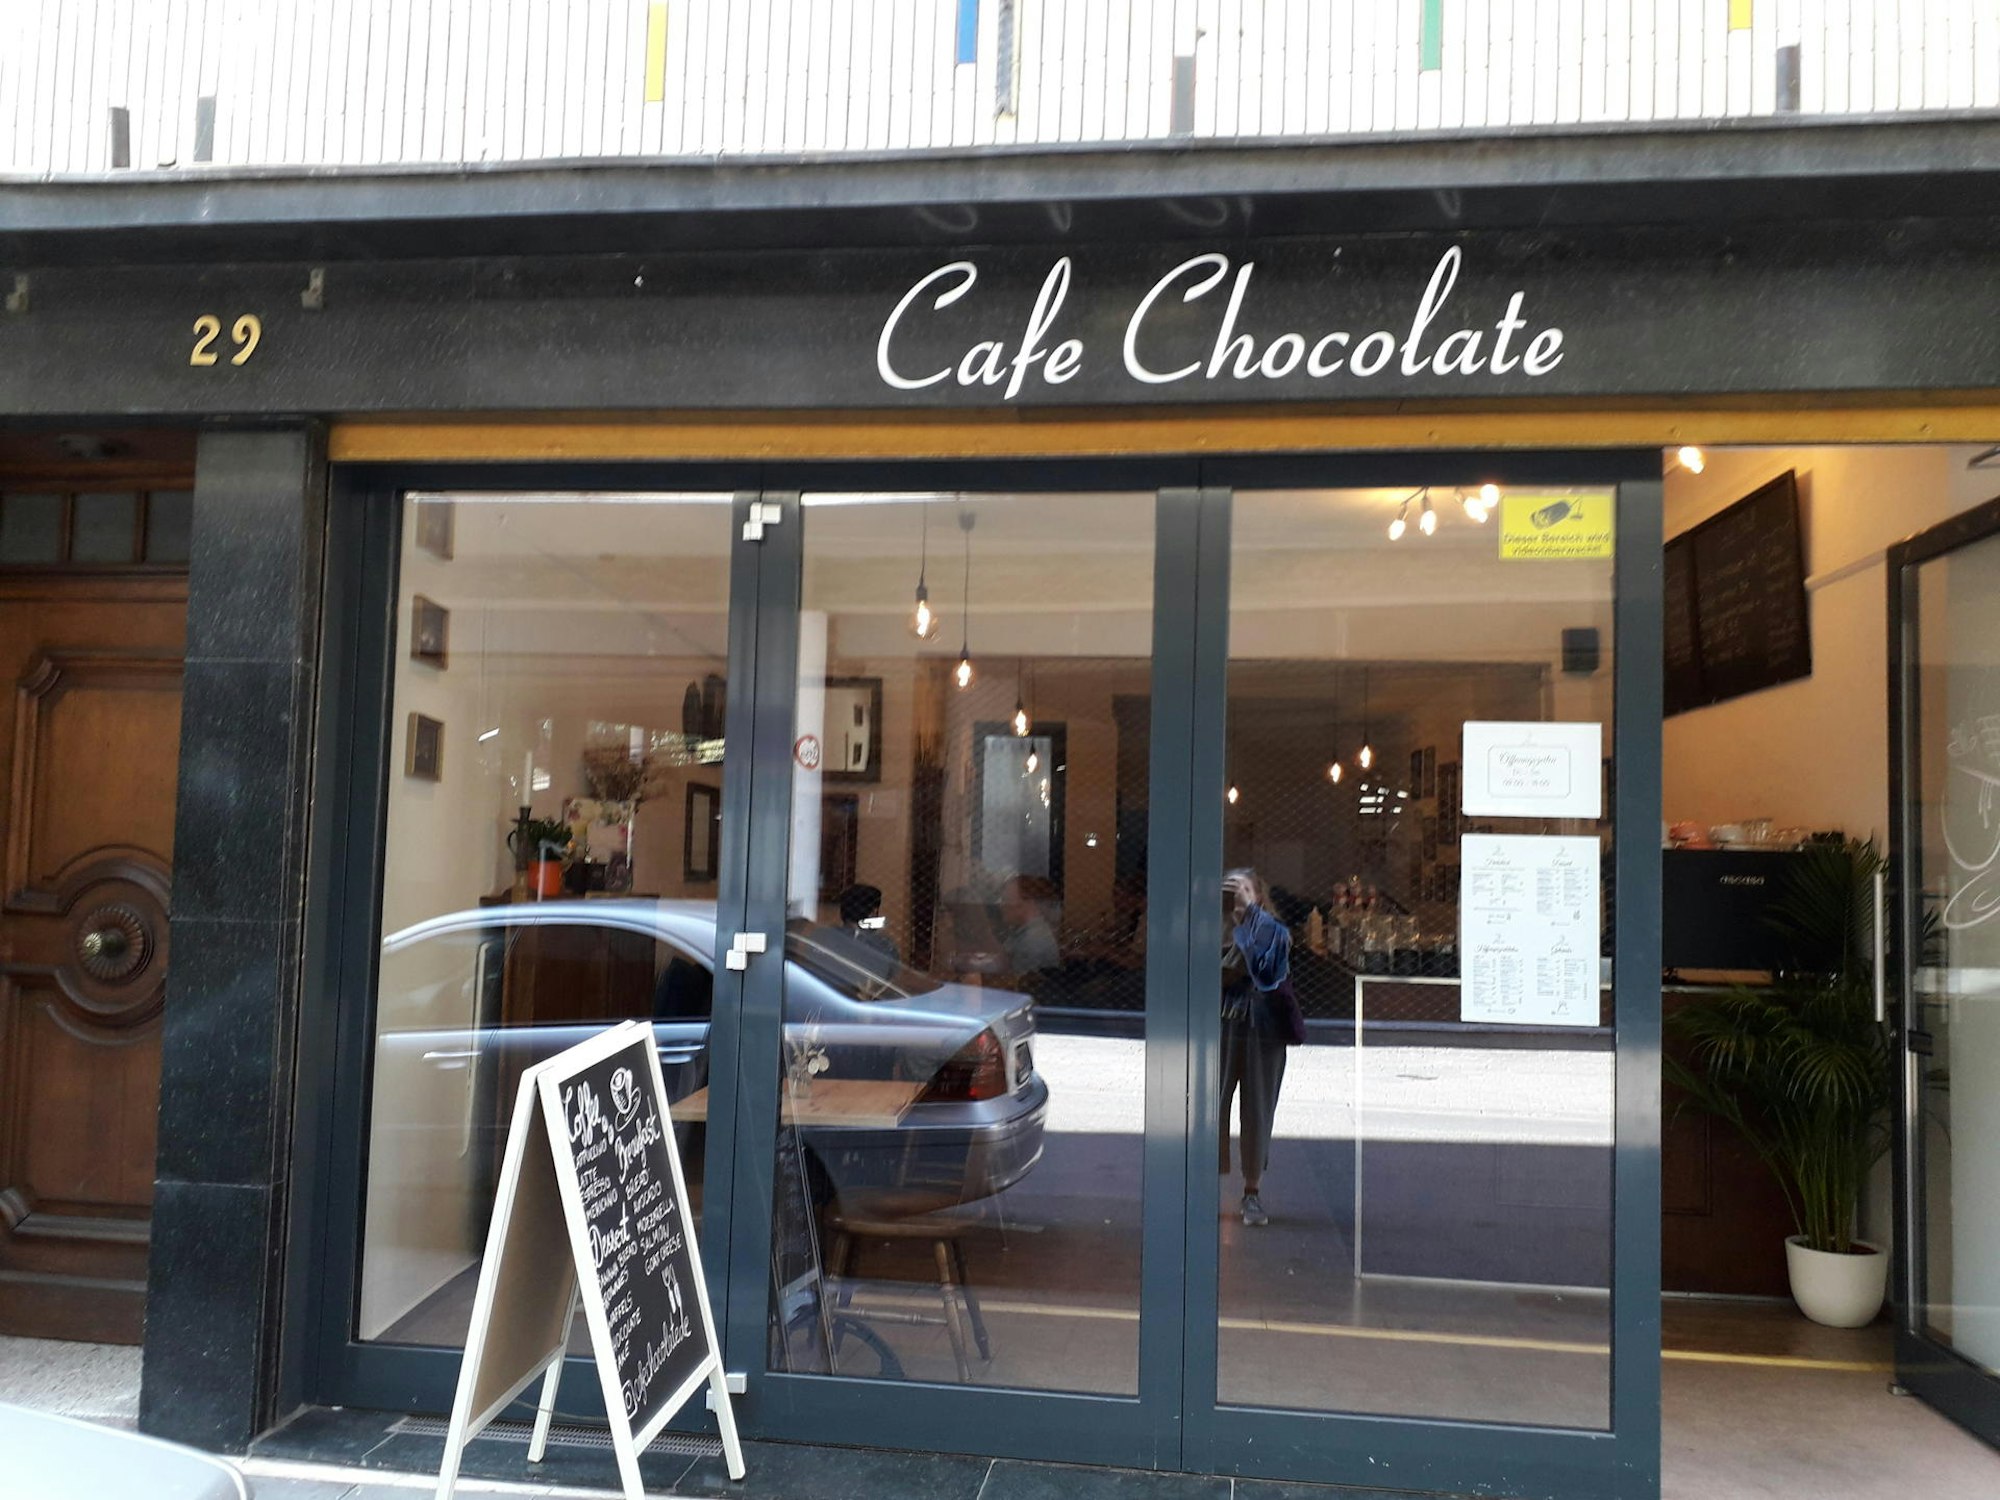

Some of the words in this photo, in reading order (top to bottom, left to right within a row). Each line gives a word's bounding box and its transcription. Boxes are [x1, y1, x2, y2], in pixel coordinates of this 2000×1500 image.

[189, 314, 262, 366] 29
[876, 256, 1084, 400] Cafe
[1123, 246, 1564, 384] Chocolate
[562, 1080, 602, 1148] Coffee
[588, 1201, 631, 1269] Dessert
[617, 1240, 638, 1268] BREAD
[640, 1221, 670, 1255] SALMON
[659, 1232, 681, 1261] CHEESE
